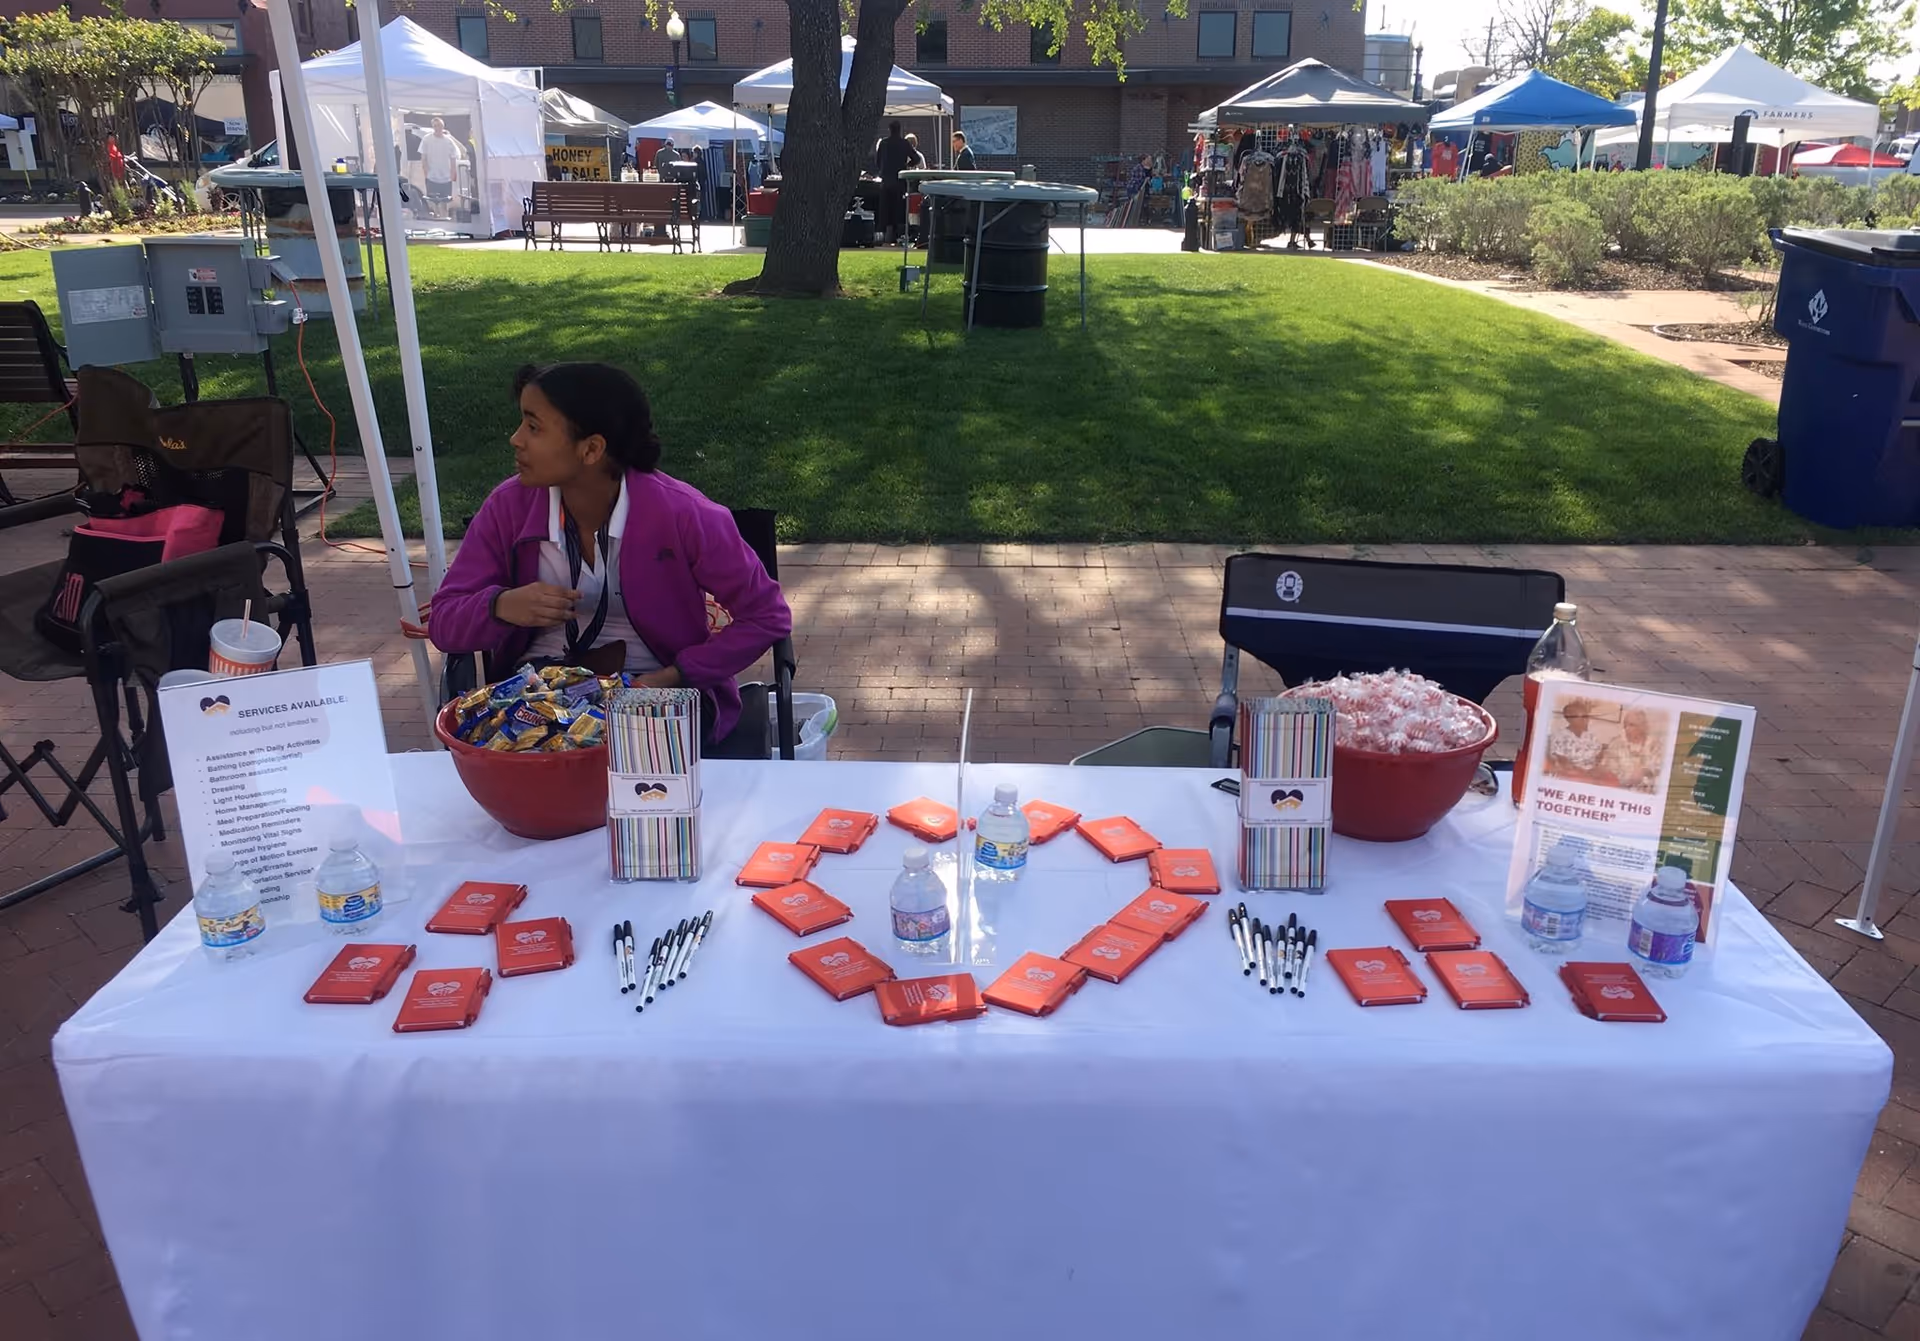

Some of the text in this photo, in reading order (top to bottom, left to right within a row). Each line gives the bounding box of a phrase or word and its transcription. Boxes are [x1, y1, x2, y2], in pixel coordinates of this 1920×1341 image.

[1763, 110, 1814, 119] FARMERS
[552, 148, 592, 162] HONEY
[238, 695, 349, 719] SERVICES AVAILABLE:
[229, 725, 261, 737] including
[262, 724, 273, 732] but
[274, 722, 286, 731] not
[287, 718, 310, 728] limited
[205, 738, 321, 762] Assistance with Daily Activities
[207, 761, 238, 773] Bathing
[209, 765, 288, 783] Bathroom assistance
[211, 783, 246, 794] Dressing
[213, 787, 287, 805] Light Housekeeping
[215, 798, 287, 815] Home Management
[1568, 792, 1596, 806] ARE
[1600, 798, 1615, 808] IN
[1619, 801, 1652, 816] THIS
[217, 804, 311, 826] Meal Preparation/Feeding
[219, 817, 301, 836] Medication Reminders
[220, 827, 302, 847] Monitoring Vital Signs
[232, 840, 287, 856] rsonal hygiene
[235, 845, 318, 868] nge of Motion Exercise
[241, 861, 293, 876] ping/Errands
[252, 875, 283, 885] ortation
[261, 893, 290, 905] ionship
